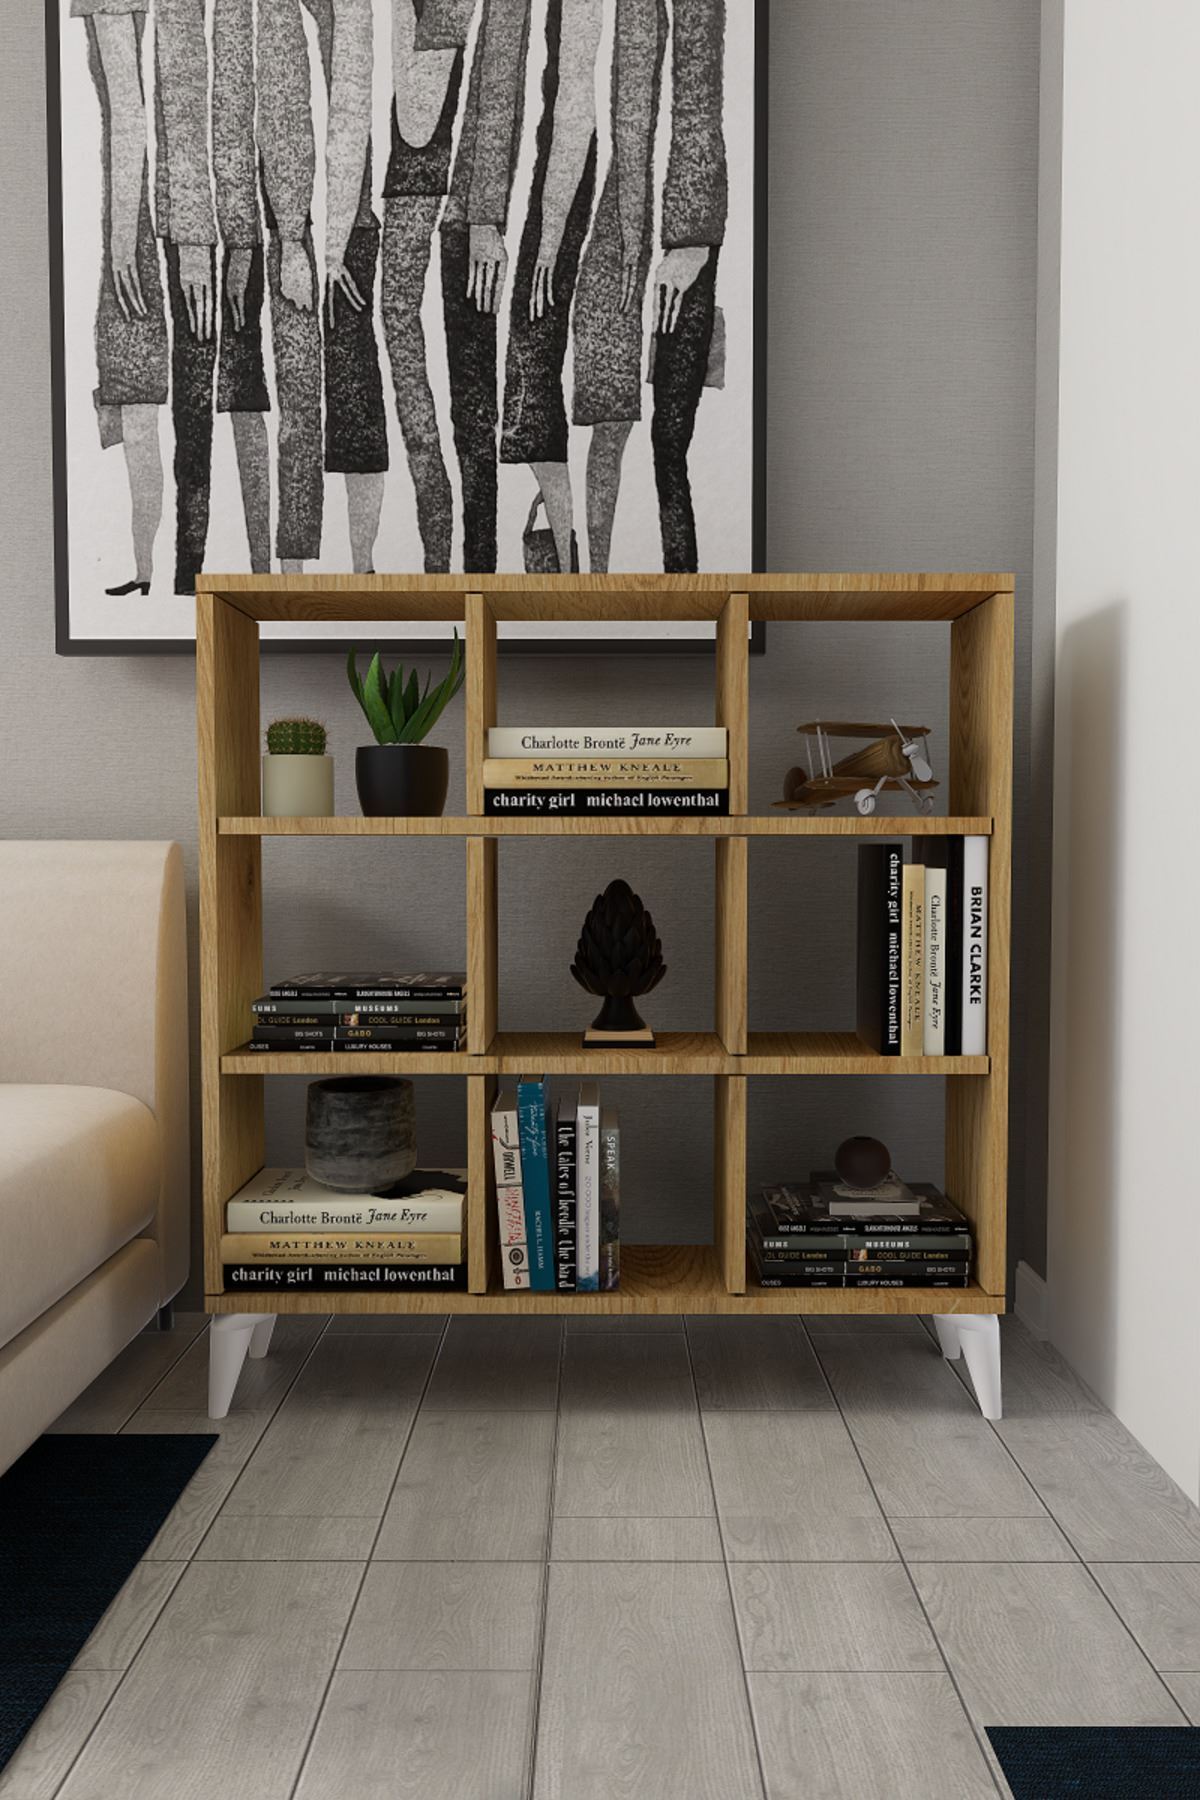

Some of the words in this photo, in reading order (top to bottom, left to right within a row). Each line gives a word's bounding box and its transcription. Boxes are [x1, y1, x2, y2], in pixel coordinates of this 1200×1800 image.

[521, 736, 579, 749] Charlotte
[584, 736, 625, 749] Brontë
[629, 733, 660, 750] Jane
[664, 733, 692, 750] Eyre
[533, 763, 612, 772] MATTHEW
[619, 763, 682, 772] KNEALE
[493, 793, 545, 810] charity
[548, 793, 575, 810] girl
[587, 793, 644, 808] michael
[647, 793, 719, 808] lowenthal
[888, 853, 899, 898] charity
[888, 901, 899, 923] girl
[930, 895, 942, 941] Charlotte
[970, 886, 982, 938] BRIAN
[888, 932, 899, 981] michael
[929, 944, 940, 977] Brontë
[970, 943, 981, 1004] CLARKE
[929, 980, 942, 1006] Jane
[354, 1004, 399, 1012] MUSEUMS
[888, 984, 899, 1044] lowenthal
[929, 1007, 941, 1029] Eyre
[292, 1015, 319, 1024] London
[414, 1015, 440, 1024] London
[558, 1127, 575, 1147] the
[606, 1136, 616, 1170] SPEAK
[504, 1151, 514, 1181] ORWELL
[558, 1151, 575, 1179] tales
[558, 1183, 575, 1196] of
[259, 1211, 317, 1225] Charlotte
[321, 1211, 362, 1225] Brontë
[366, 1208, 397, 1225] Jane
[400, 1208, 428, 1225] Eyre
[558, 1199, 575, 1236] beedle
[269, 1241, 348, 1249] MATTHEW
[354, 1241, 416, 1249] KNEALE
[558, 1240, 575, 1259] the
[865, 1240, 910, 1248] MUSEUMS
[231, 1268, 283, 1284] charity
[286, 1268, 313, 1284] girl
[324, 1268, 380, 1282] michael
[384, 1268, 454, 1282] lowenthal
